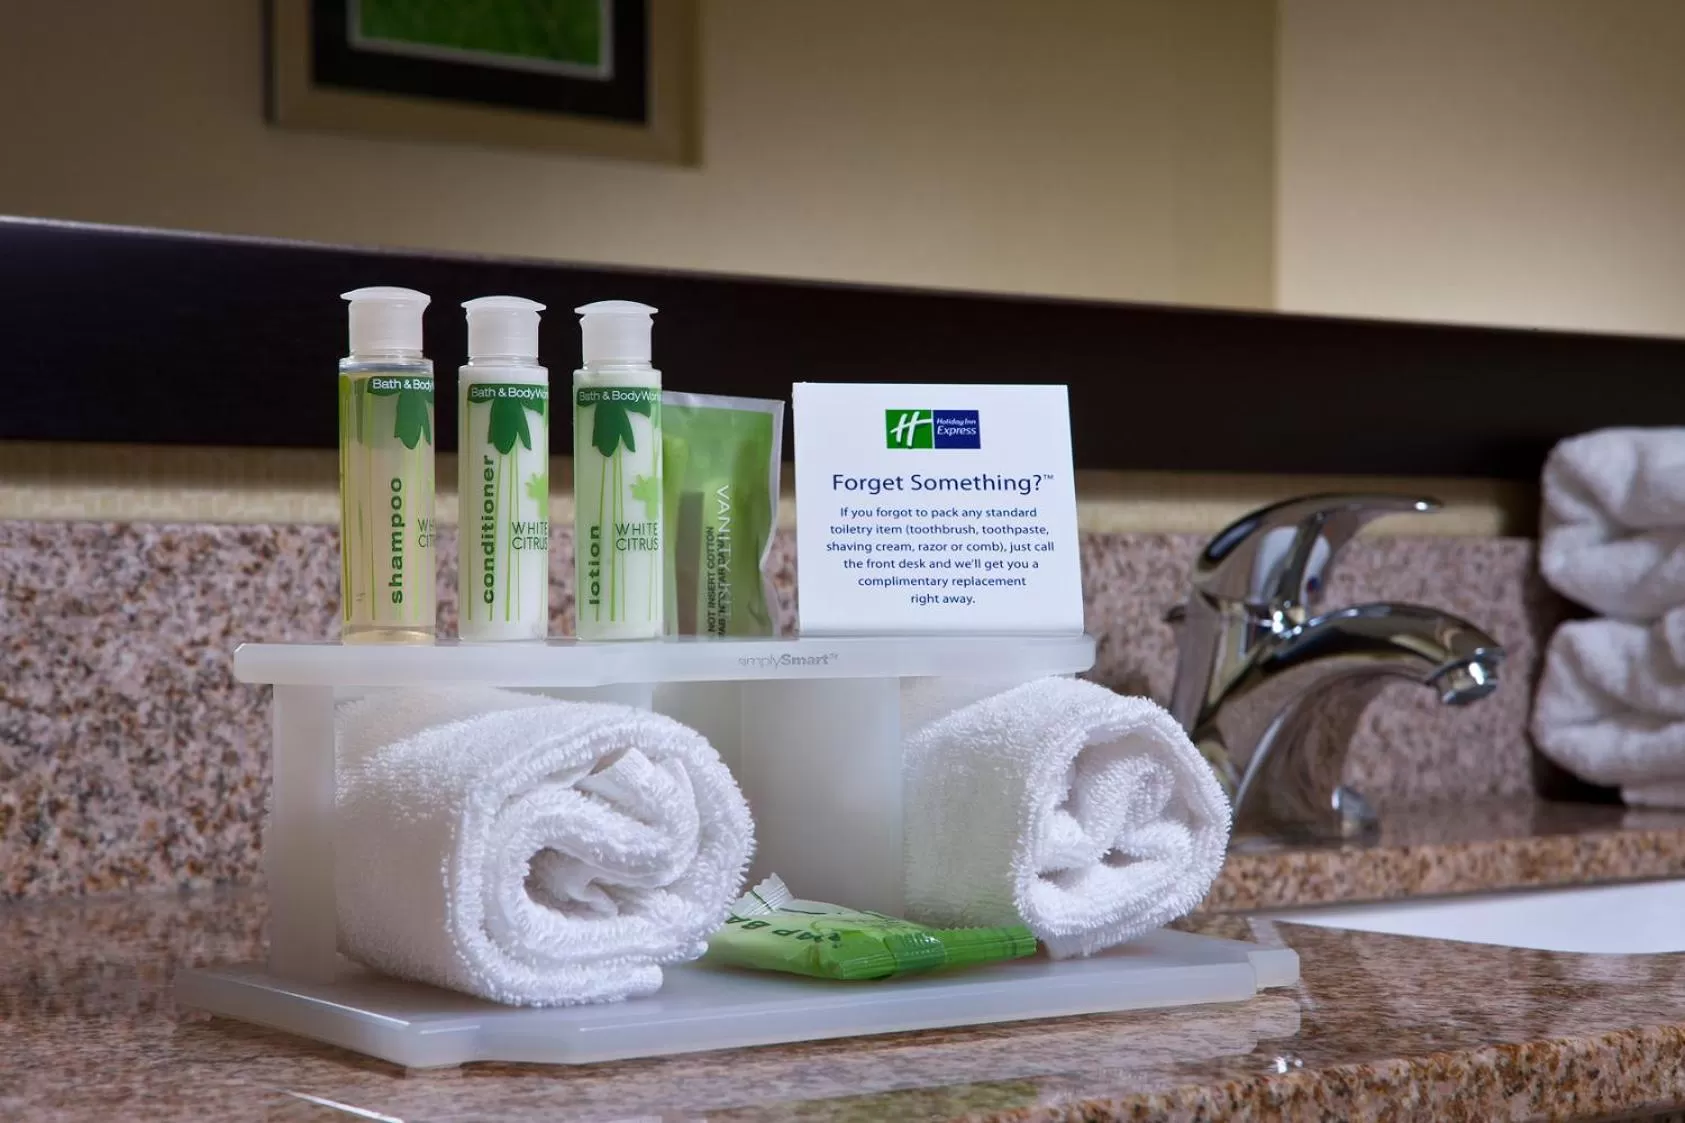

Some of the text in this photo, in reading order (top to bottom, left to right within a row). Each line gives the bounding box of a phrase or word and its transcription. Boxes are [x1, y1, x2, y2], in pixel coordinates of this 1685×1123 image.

[372, 378, 402, 390] Bath
[403, 379, 412, 390] &
[471, 387, 496, 398] Bath
[498, 387, 507, 398] &
[937, 425, 977, 437] Express
[833, 474, 904, 496] Forget
[840, 507, 1037, 520] If you forgot to pack any standard
[481, 455, 495, 605] conditioner
[511, 521, 548, 535] WHITE
[615, 522, 658, 536] WHITE
[716, 484, 732, 572] VANITY
[830, 524, 1049, 538] toiletry item (toothbrush, toothpaste,
[388, 477, 405, 605] shampoo
[615, 537, 659, 551] CITRUS
[826, 541, 1054, 555] shaving cream, razor or comb), just call
[588, 525, 601, 605] lotion
[843, 558, 1038, 572] the front desk and we'll get you a
[706, 526, 716, 633] NOT INSERT COTTON
[856, 576, 1027, 589] complimentary replacement
[911, 593, 975, 607] right away.
